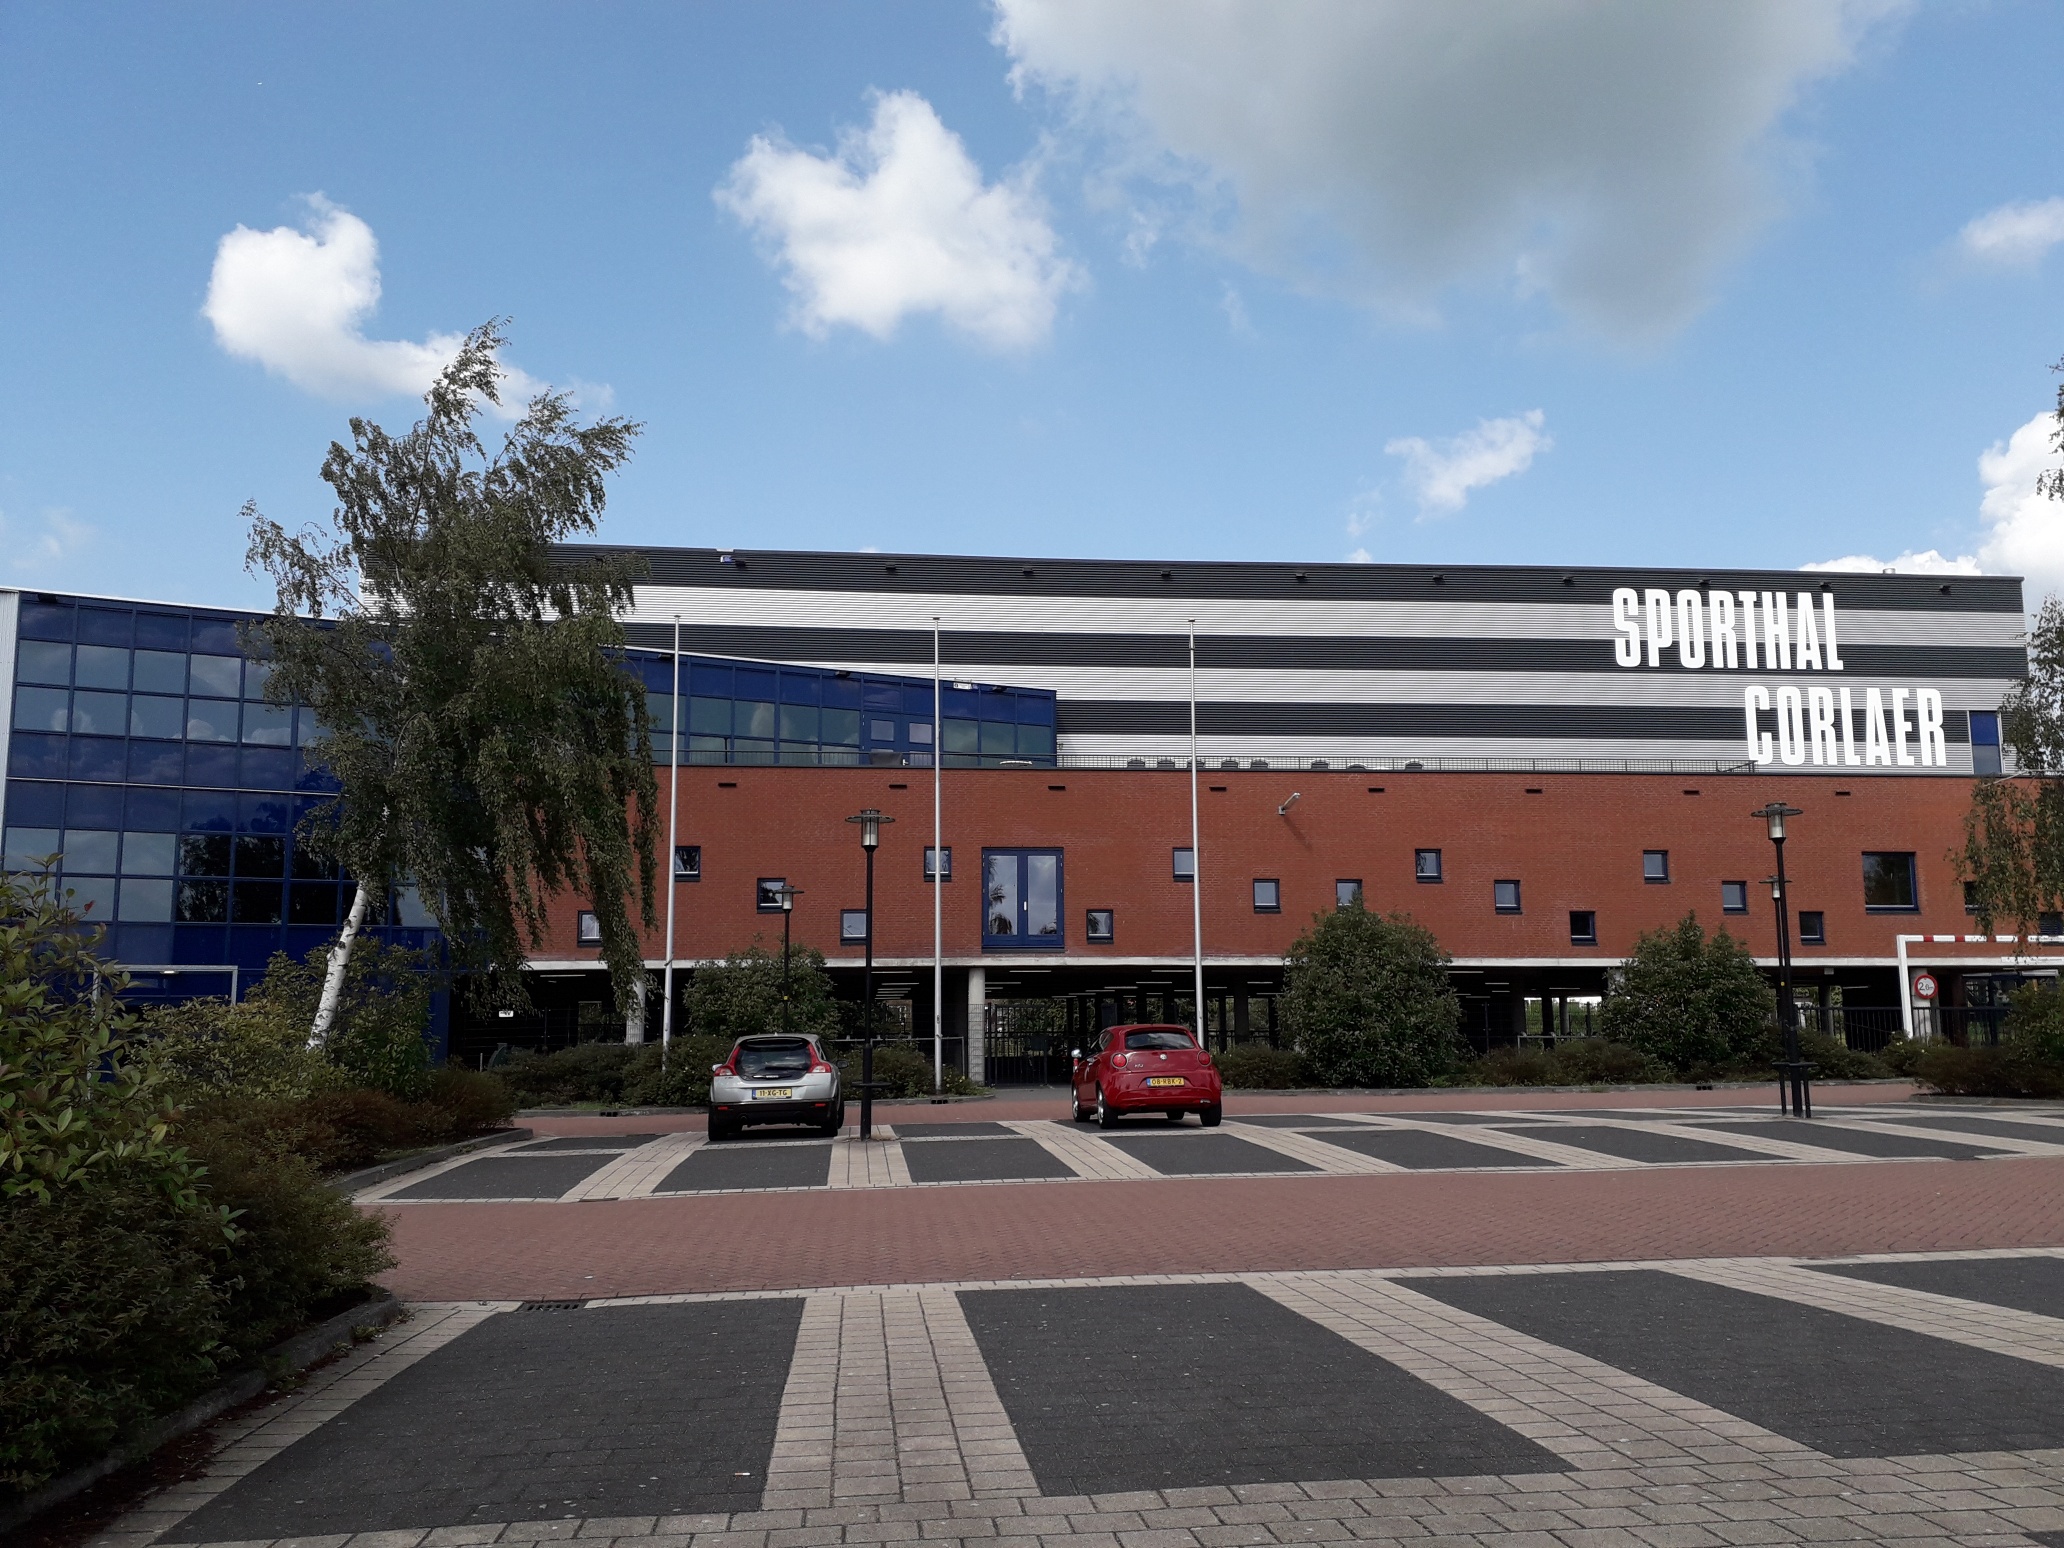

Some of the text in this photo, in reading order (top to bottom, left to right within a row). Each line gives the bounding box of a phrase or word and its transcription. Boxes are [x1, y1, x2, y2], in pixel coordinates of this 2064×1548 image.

[1612, 587, 1844, 671] SPORTHAL
[1744, 685, 1947, 767] CORLAER
[759, 1089, 788, 1097] 11-XG-TG
